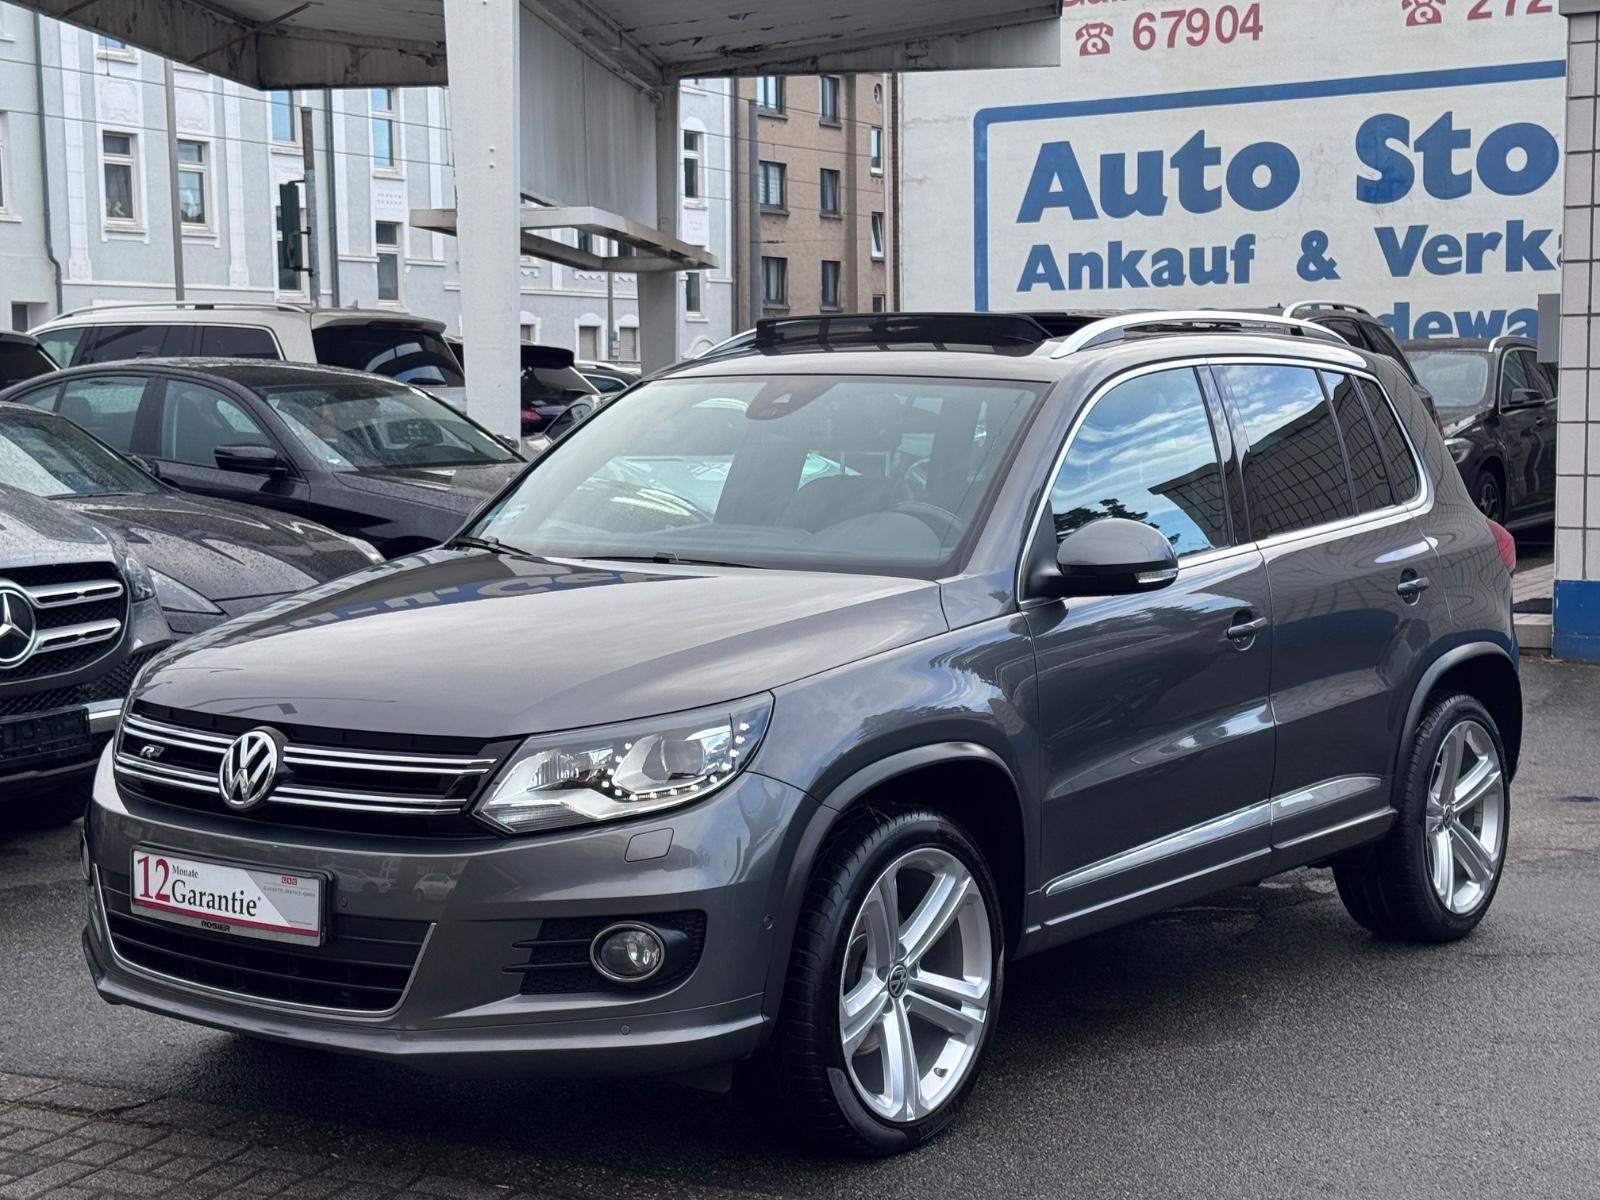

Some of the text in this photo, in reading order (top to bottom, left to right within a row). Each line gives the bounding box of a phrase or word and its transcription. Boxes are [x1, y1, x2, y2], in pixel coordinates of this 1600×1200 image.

[1133, 3, 1264, 51] 67904
[1016, 111, 1560, 223] Auto Sto
[1016, 219, 1562, 292] Ankauf & Verk
[137, 855, 170, 903] 12
[172, 864, 199, 879] Monate
[201, 920, 230, 932] ROSIER
